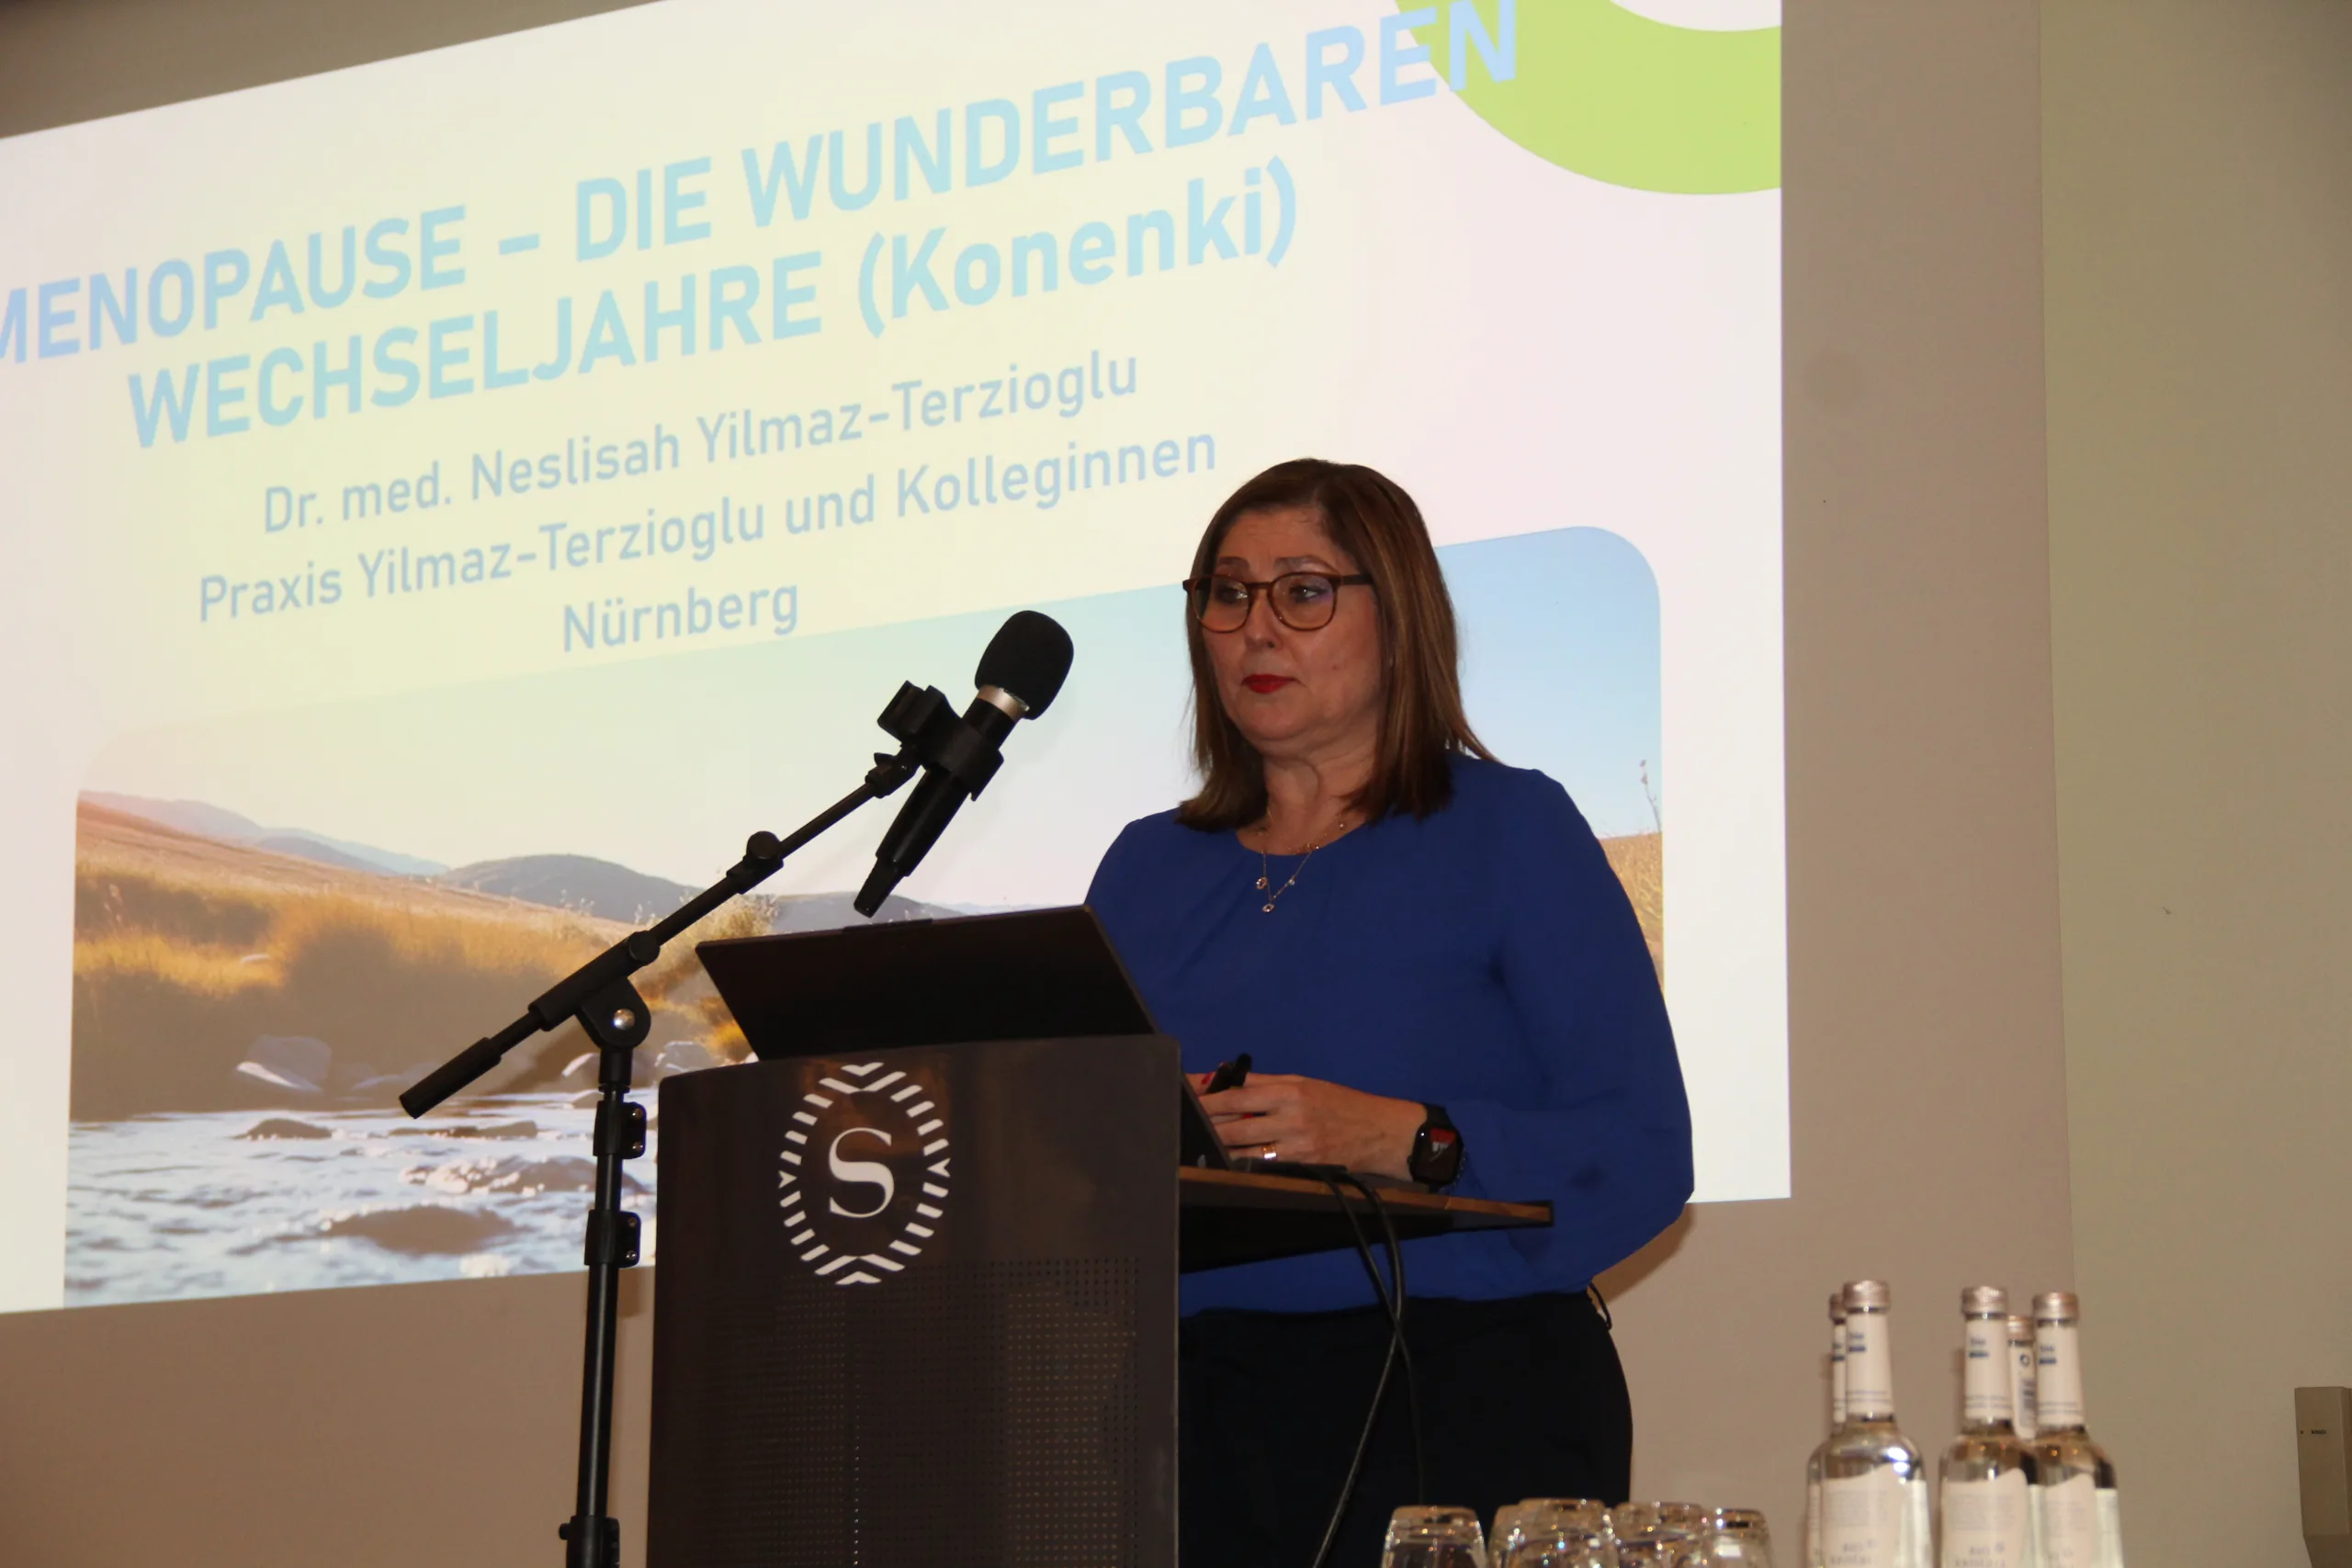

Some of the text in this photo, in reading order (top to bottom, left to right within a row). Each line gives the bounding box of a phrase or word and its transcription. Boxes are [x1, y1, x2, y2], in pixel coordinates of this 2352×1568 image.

[576, 156, 713, 263] DIE
[741, 0, 1518, 229] WUNDERBAREN
[129, 155, 1297, 449] WECHSELJAHRE (Konenki)
[200, 433, 1217, 623] Praxis Yilmaz-Terzioglu und Kolleginnen
[265, 349, 1138, 534] Dr. med. Neslisah Yilmaz-Terzioglu
[563, 584, 798, 652] Nürnberg
[829, 1127, 895, 1219] S
